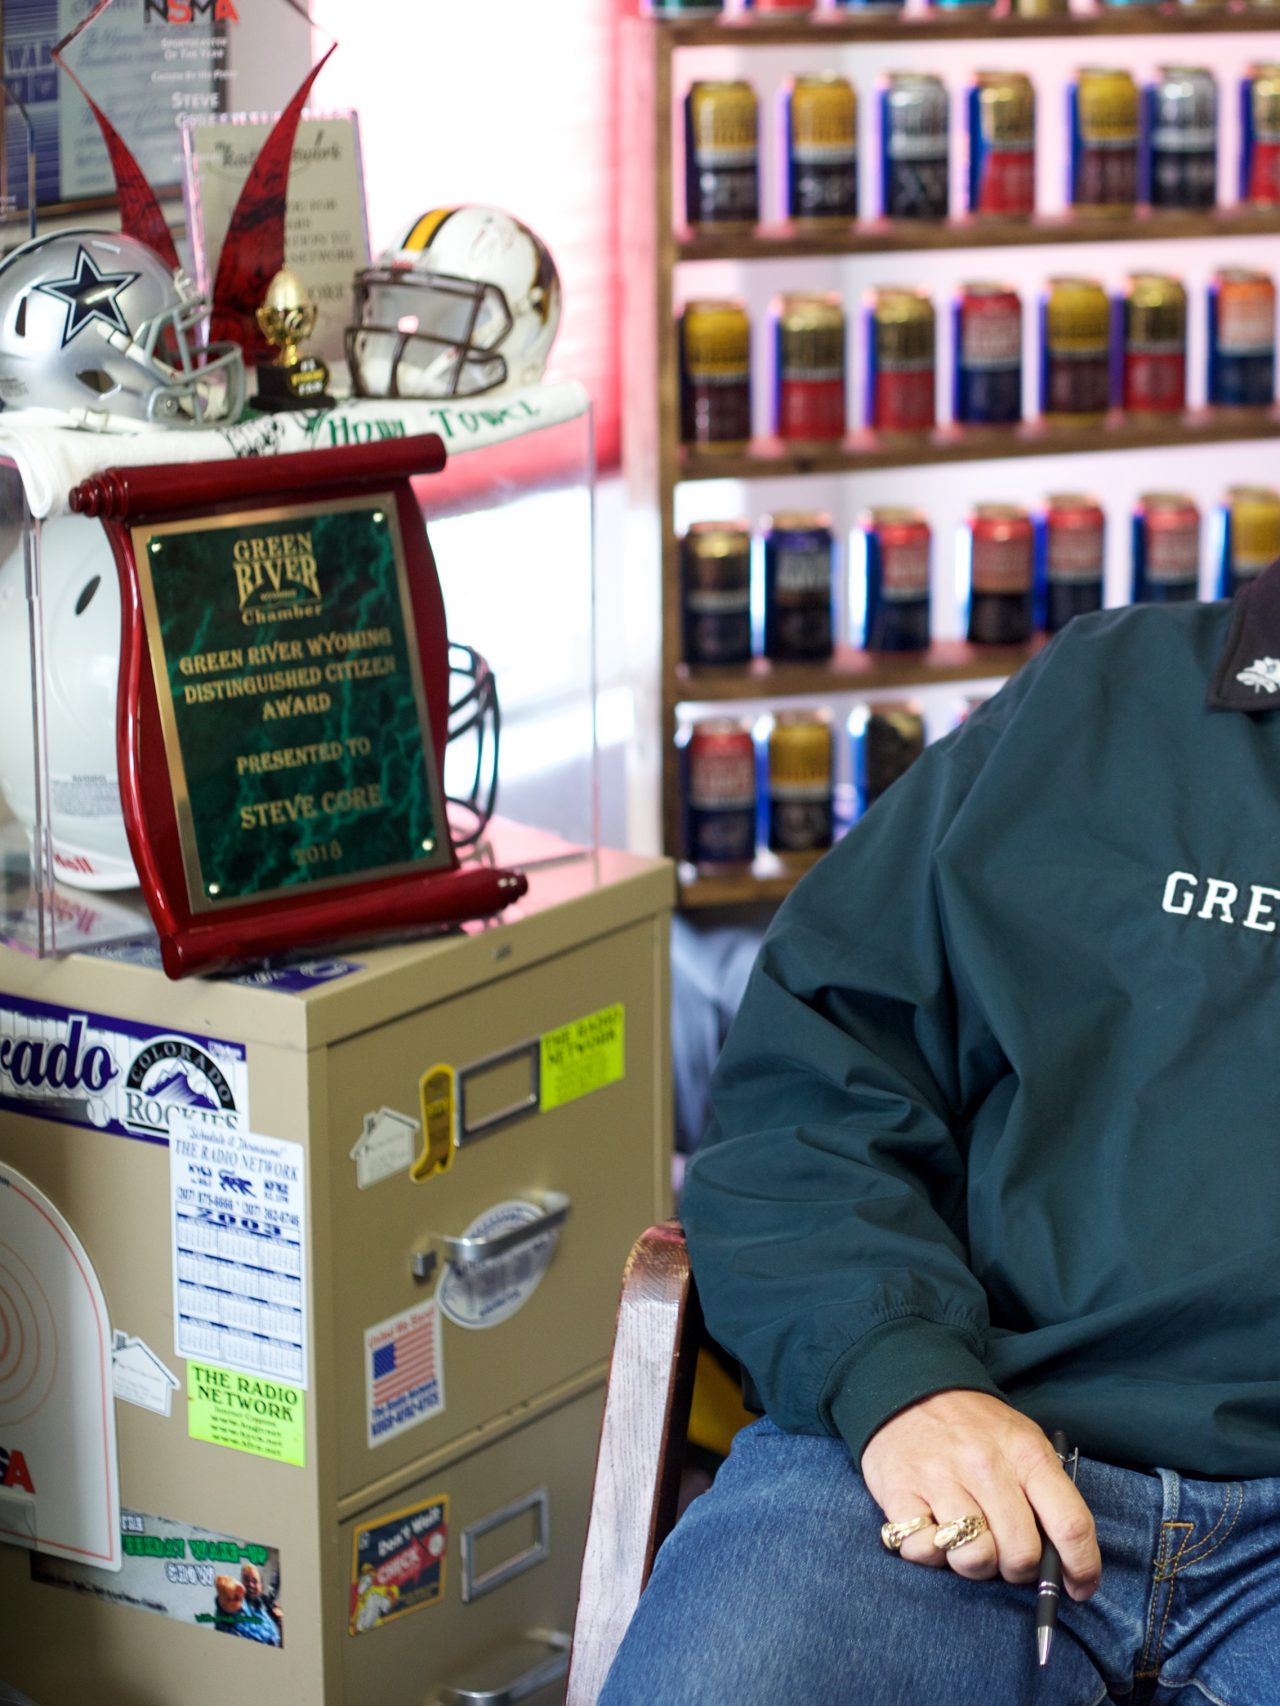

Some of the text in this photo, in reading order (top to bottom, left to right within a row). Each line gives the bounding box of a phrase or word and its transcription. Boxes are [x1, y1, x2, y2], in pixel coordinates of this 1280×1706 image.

[143, 0, 240, 25] NSMA
[233, 531, 313, 561] GREEN
[233, 553, 321, 611] RIVER
[242, 603, 322, 626] Chamber
[179, 627, 393, 676] GREEN RIVER WYOMING
[184, 654, 396, 704] DISTINGUISHED CITIZEN
[262, 692, 332, 721] AWARD
[236, 736, 371, 775] PRESENTED TO
[240, 784, 384, 830] STEVE CORE
[132, 1040, 233, 1102] COLORADO
[175, 1139, 199, 1160] THE
[201, 1146, 238, 1167] RADIO
[241, 1154, 298, 1182] NETWORK
[192, 1365, 231, 1389] THE
[237, 1377, 297, 1405] RADIO
[198, 1386, 293, 1423] NETWORK
[378, 1524, 411, 1557] Don't
[166, 1563, 216, 1587] SHOW
